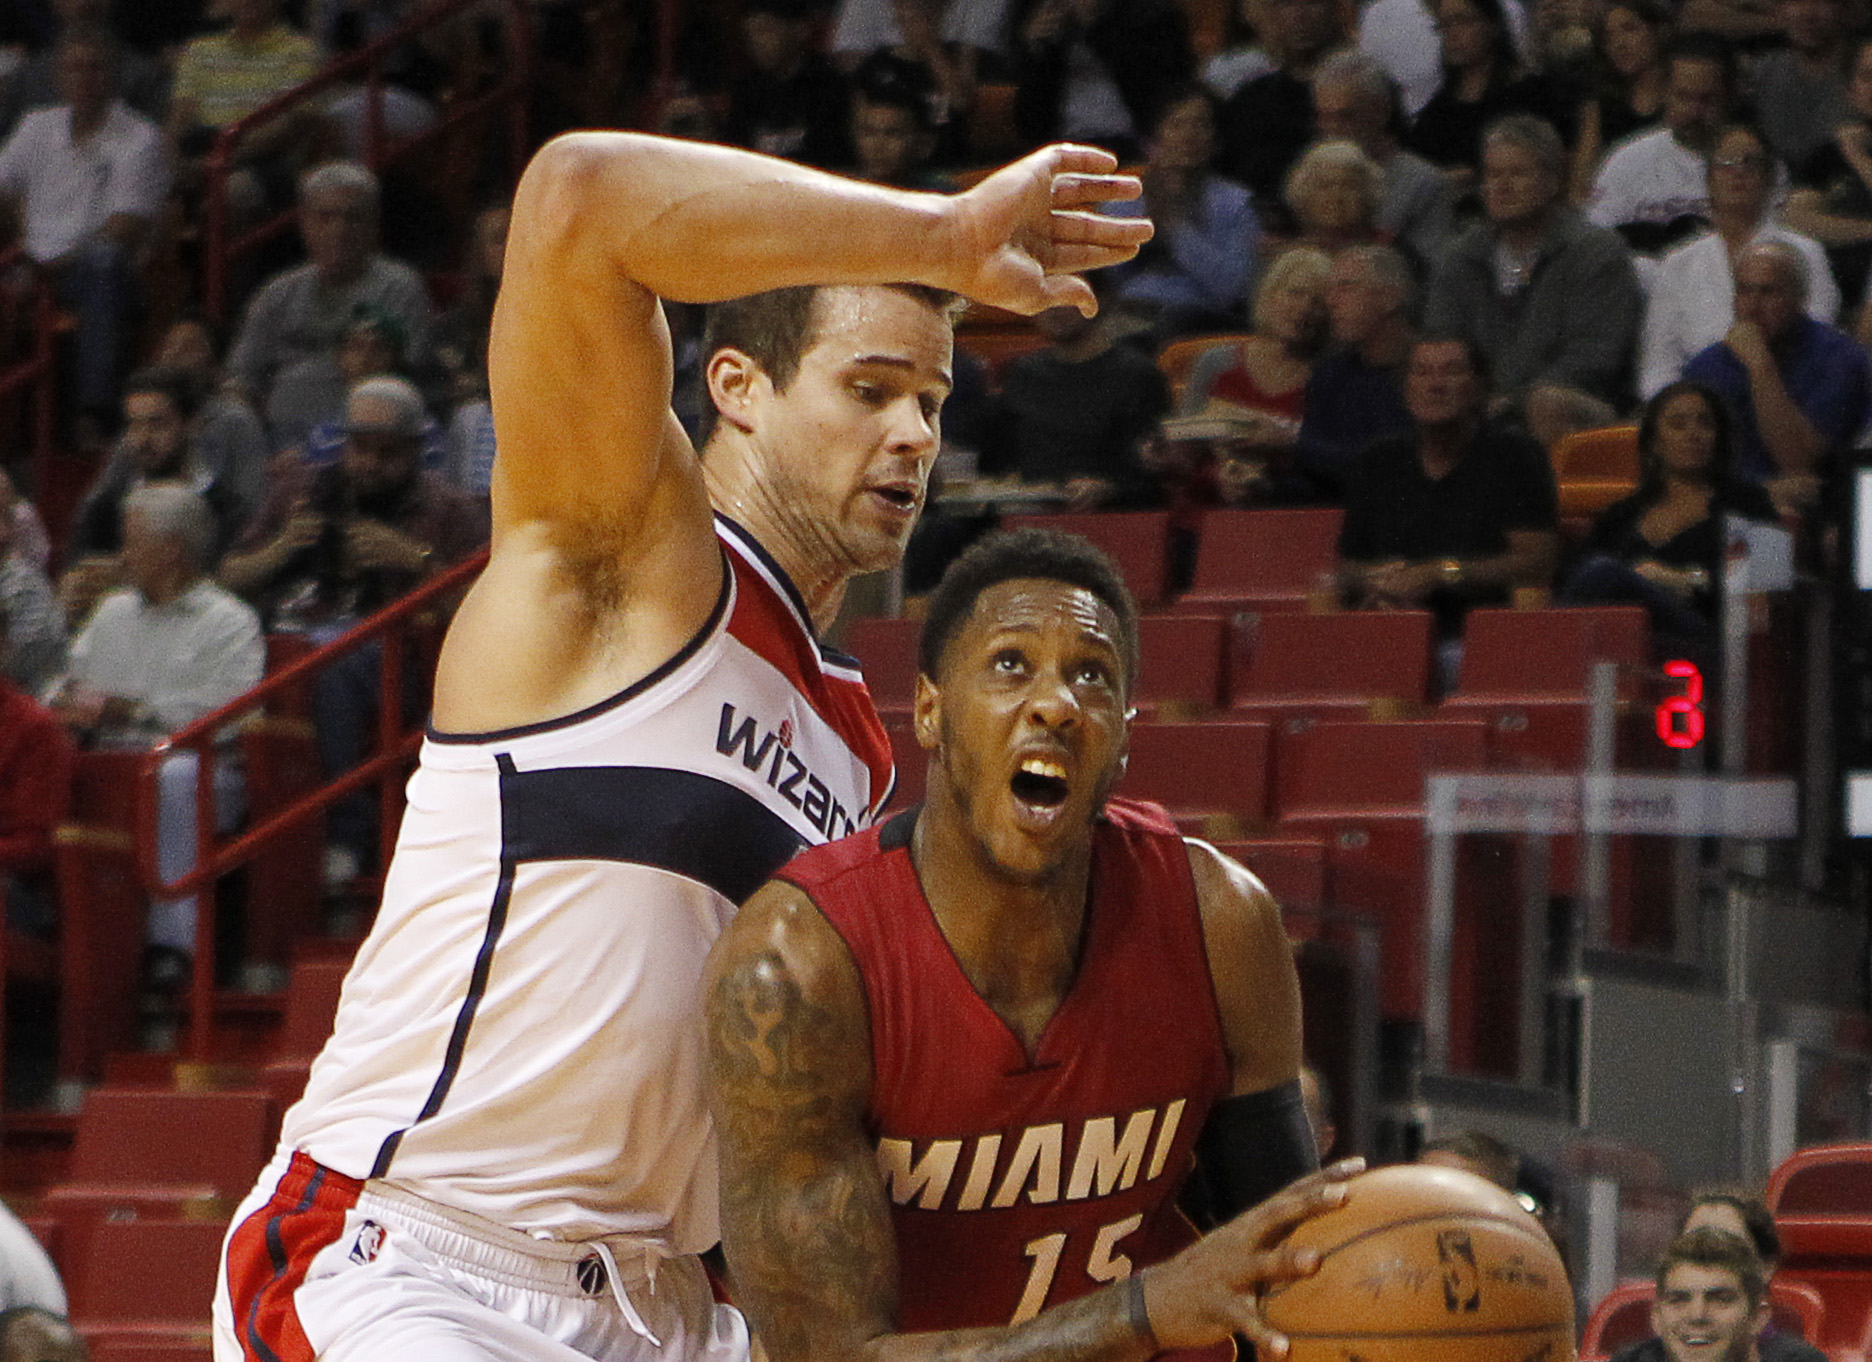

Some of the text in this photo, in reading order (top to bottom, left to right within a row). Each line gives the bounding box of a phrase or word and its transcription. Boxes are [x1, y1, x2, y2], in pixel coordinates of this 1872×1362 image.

[715, 702, 868, 843] Wizar
[877, 1098, 1187, 1211] MIAMI
[1008, 1213, 1143, 1328] 15
